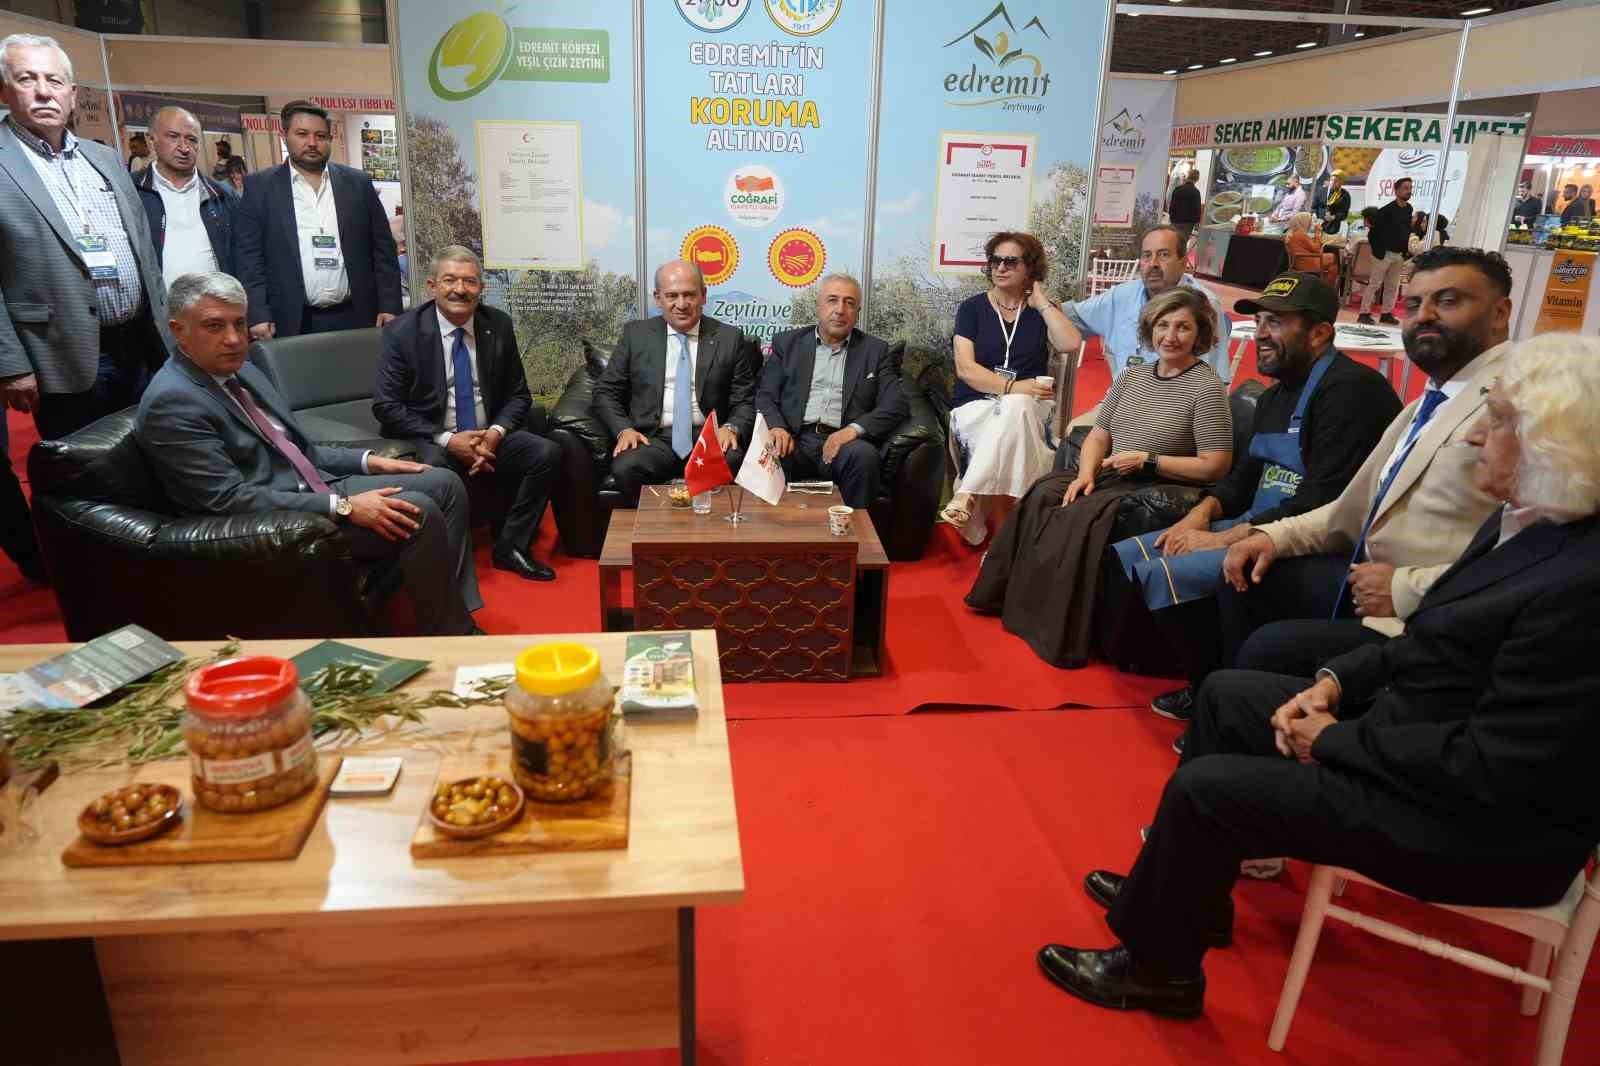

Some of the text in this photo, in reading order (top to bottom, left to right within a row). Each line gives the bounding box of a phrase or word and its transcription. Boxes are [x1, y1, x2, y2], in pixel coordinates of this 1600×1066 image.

[688, 41, 824, 69] EDREMİT'İN
[709, 71, 804, 96] TATLARI
[690, 96, 821, 128] KORUMA
[706, 129, 805, 153] ALTINDA
[1266, 115, 1326, 142] AHMET
[730, 192, 777, 205] COĞRAFİ
[713, 299, 792, 320] Zeytin ve
